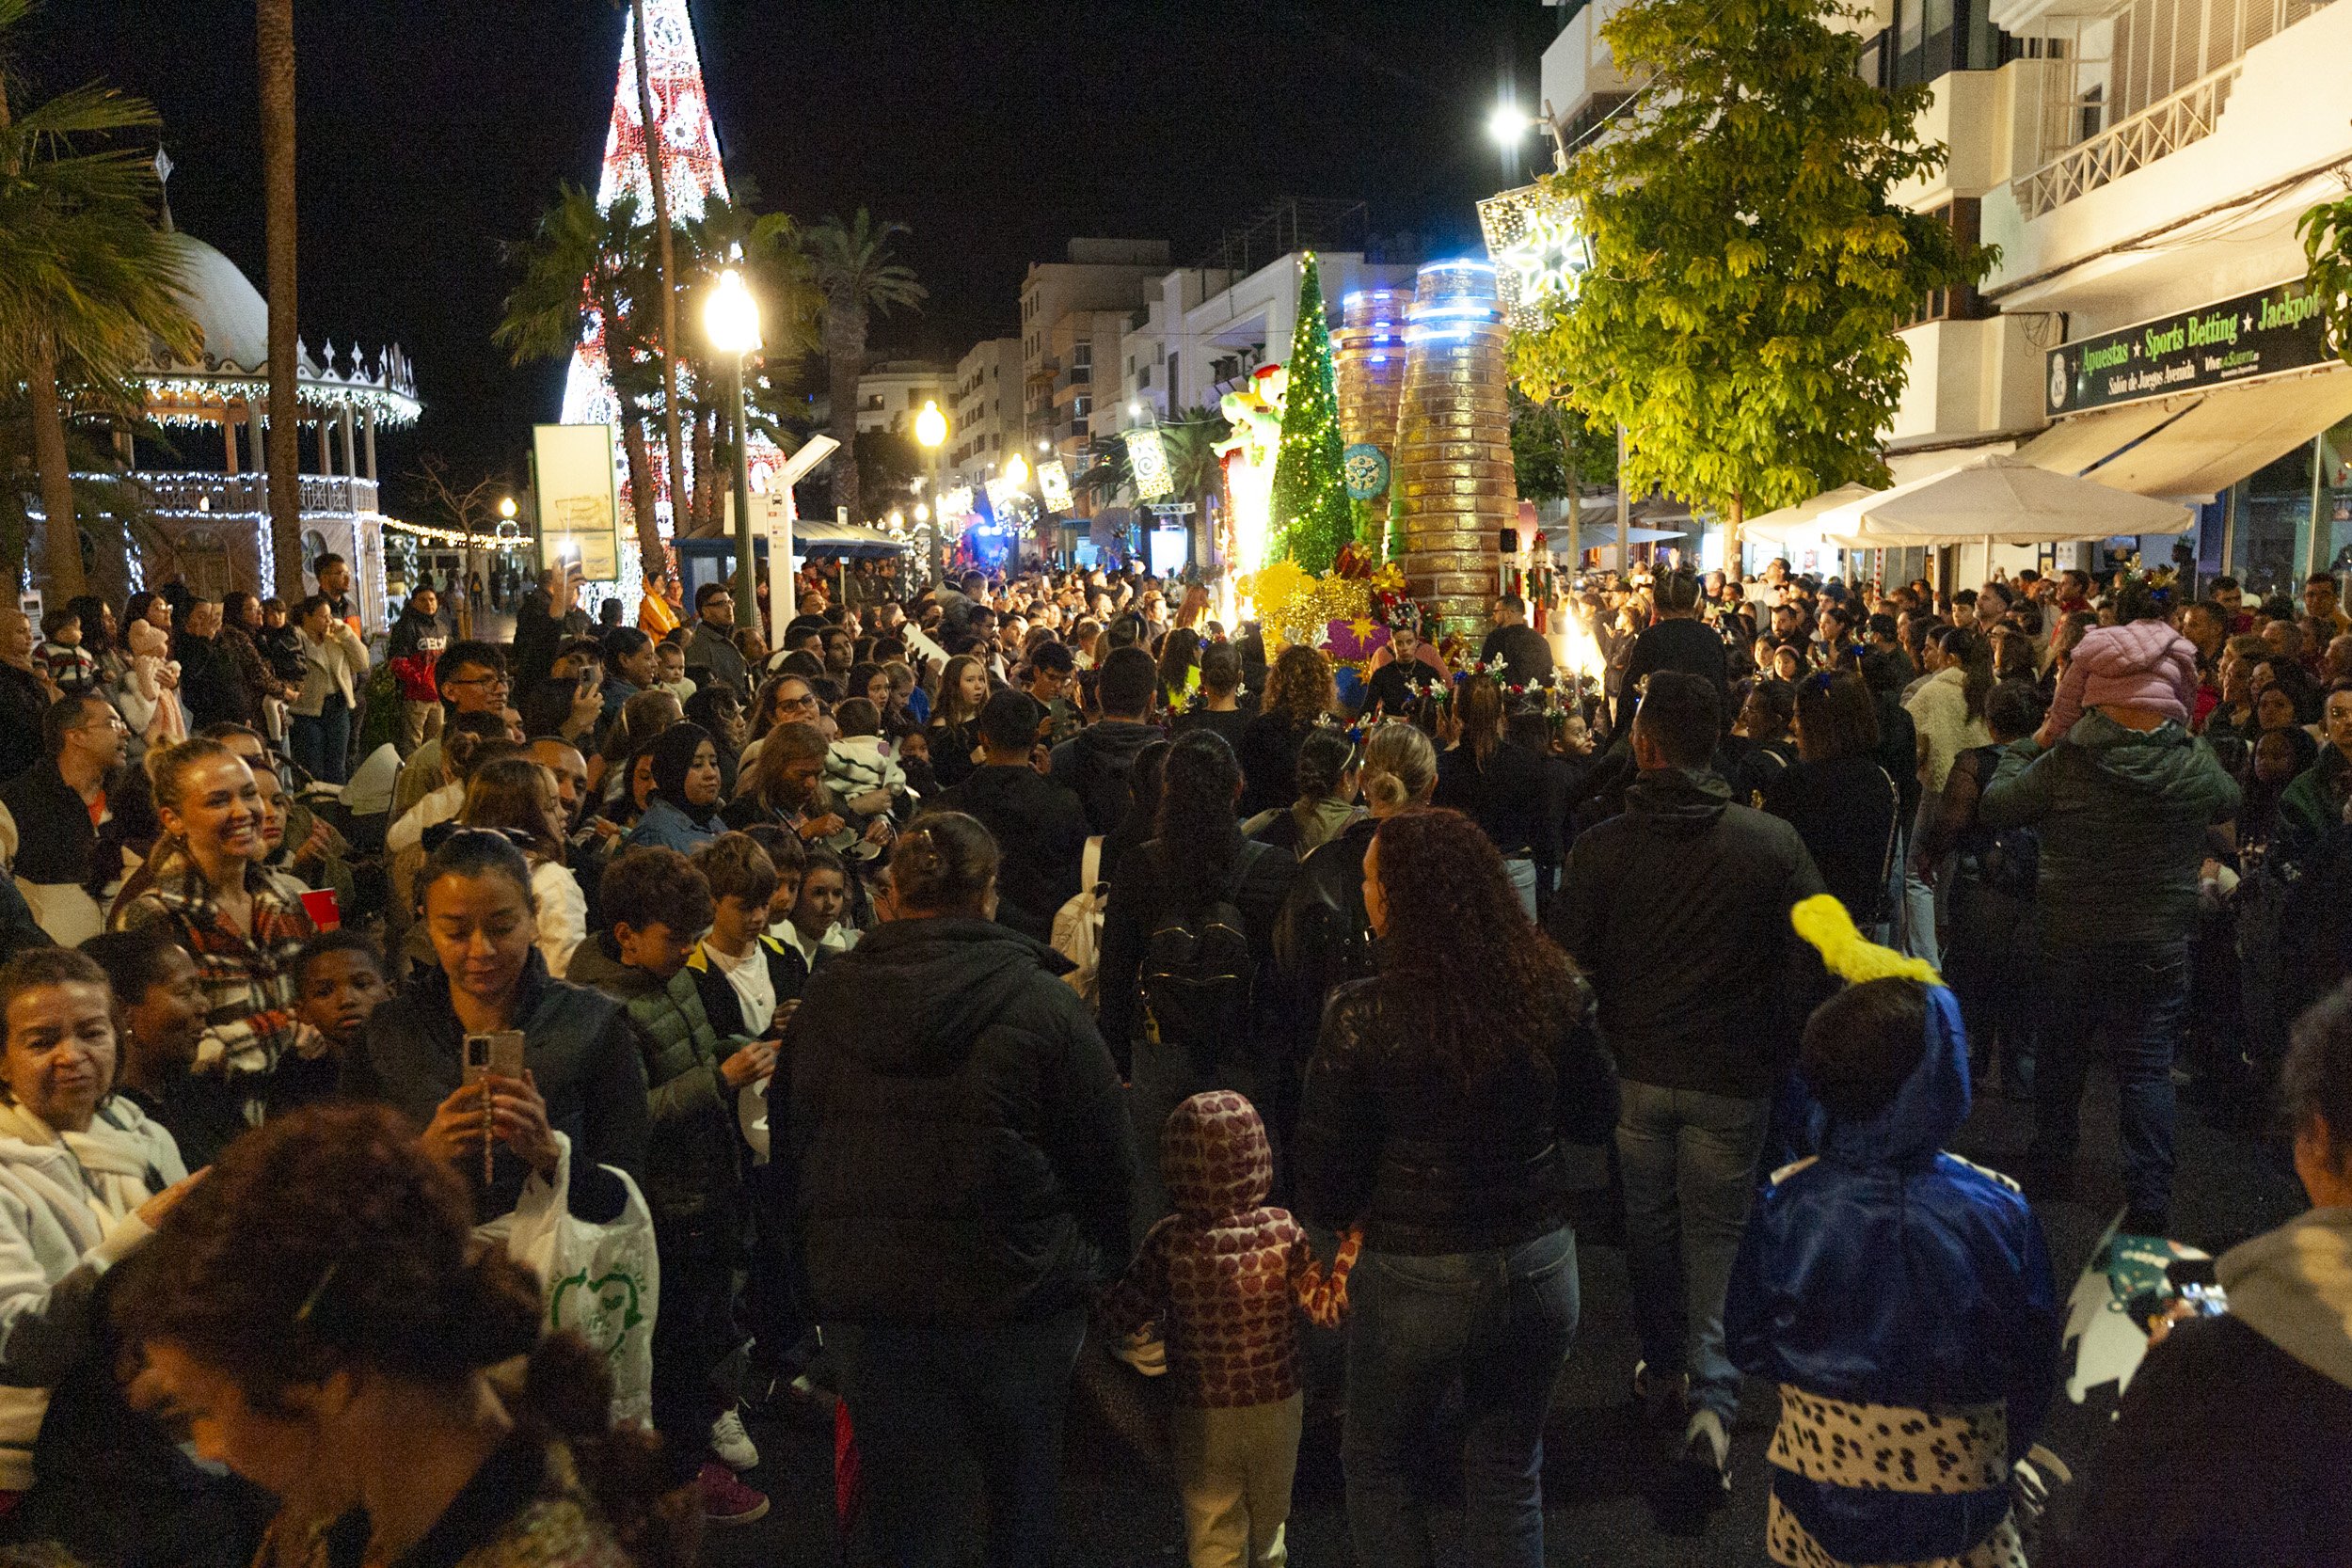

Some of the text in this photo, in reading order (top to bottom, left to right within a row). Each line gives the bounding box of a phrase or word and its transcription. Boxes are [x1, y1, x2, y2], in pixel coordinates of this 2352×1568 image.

[2083, 284, 2320, 376] Apuestas Sports Betting Jackpot
[2108, 359, 2195, 396] Salón de Juegos Avenida
